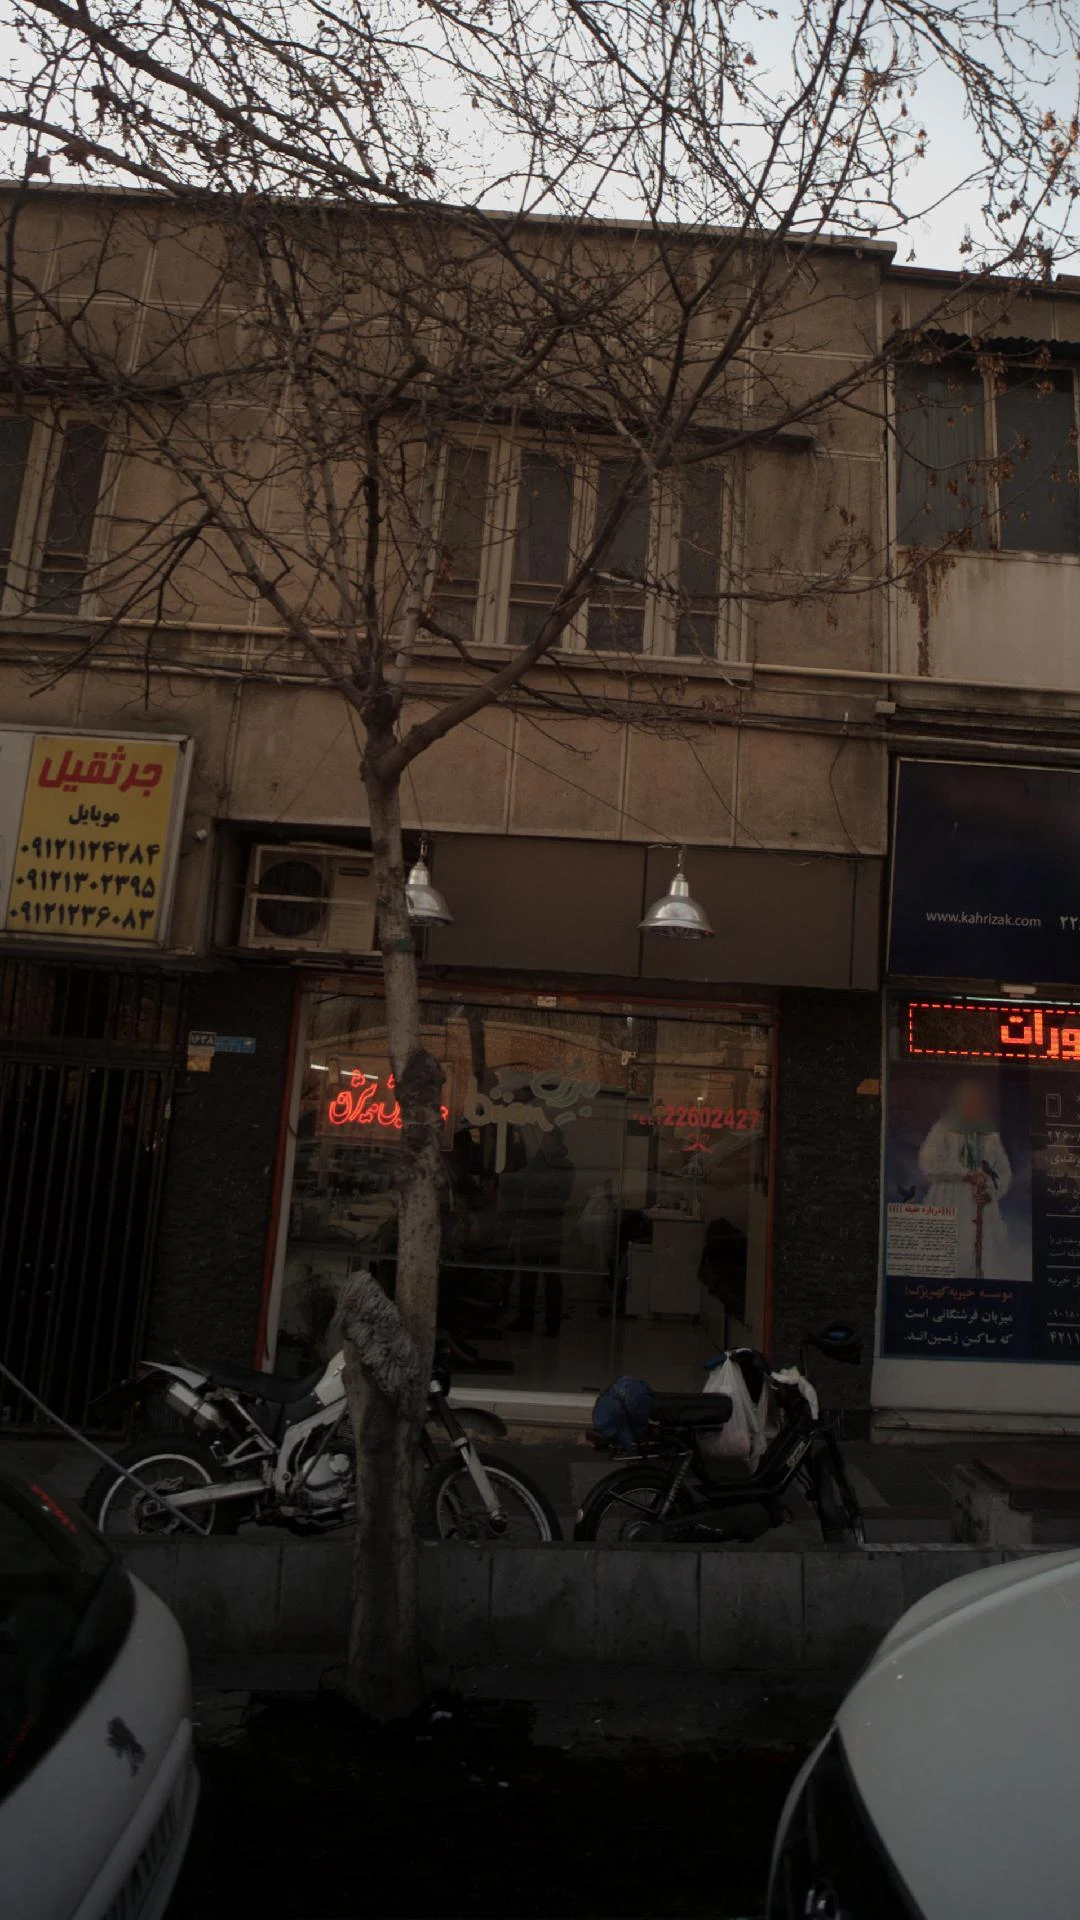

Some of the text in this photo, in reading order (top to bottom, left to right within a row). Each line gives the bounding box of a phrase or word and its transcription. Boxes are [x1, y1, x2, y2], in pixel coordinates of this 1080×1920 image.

[38, 745, 164, 798] جرثقیل
[69, 804, 120, 828] موبایل
[926, 910, 1042, 928] www.kahrizak.com
[904, 1307, 1014, 1327] میزبان فرشتگانی است
[961, 1331, 997, 1348] ساکن
